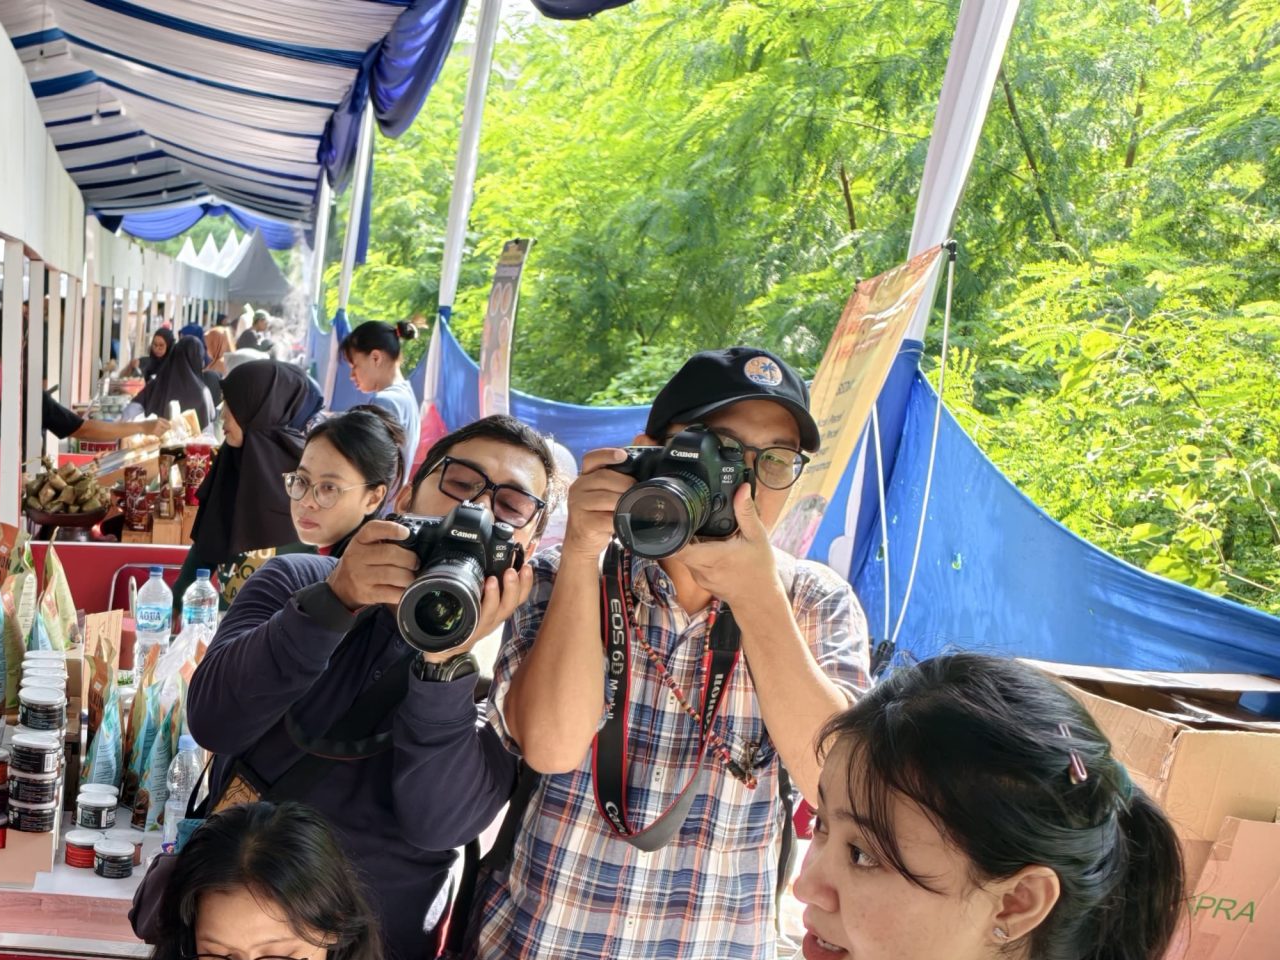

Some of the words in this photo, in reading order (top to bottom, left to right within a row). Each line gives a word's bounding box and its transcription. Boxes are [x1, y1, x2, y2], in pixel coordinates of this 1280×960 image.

[670, 450, 699, 459] Canon
[451, 529, 478, 540] Canon
[139, 611, 161, 621] AQUA
[611, 598, 624, 645] EOS
[611, 650, 624, 675] 6D
